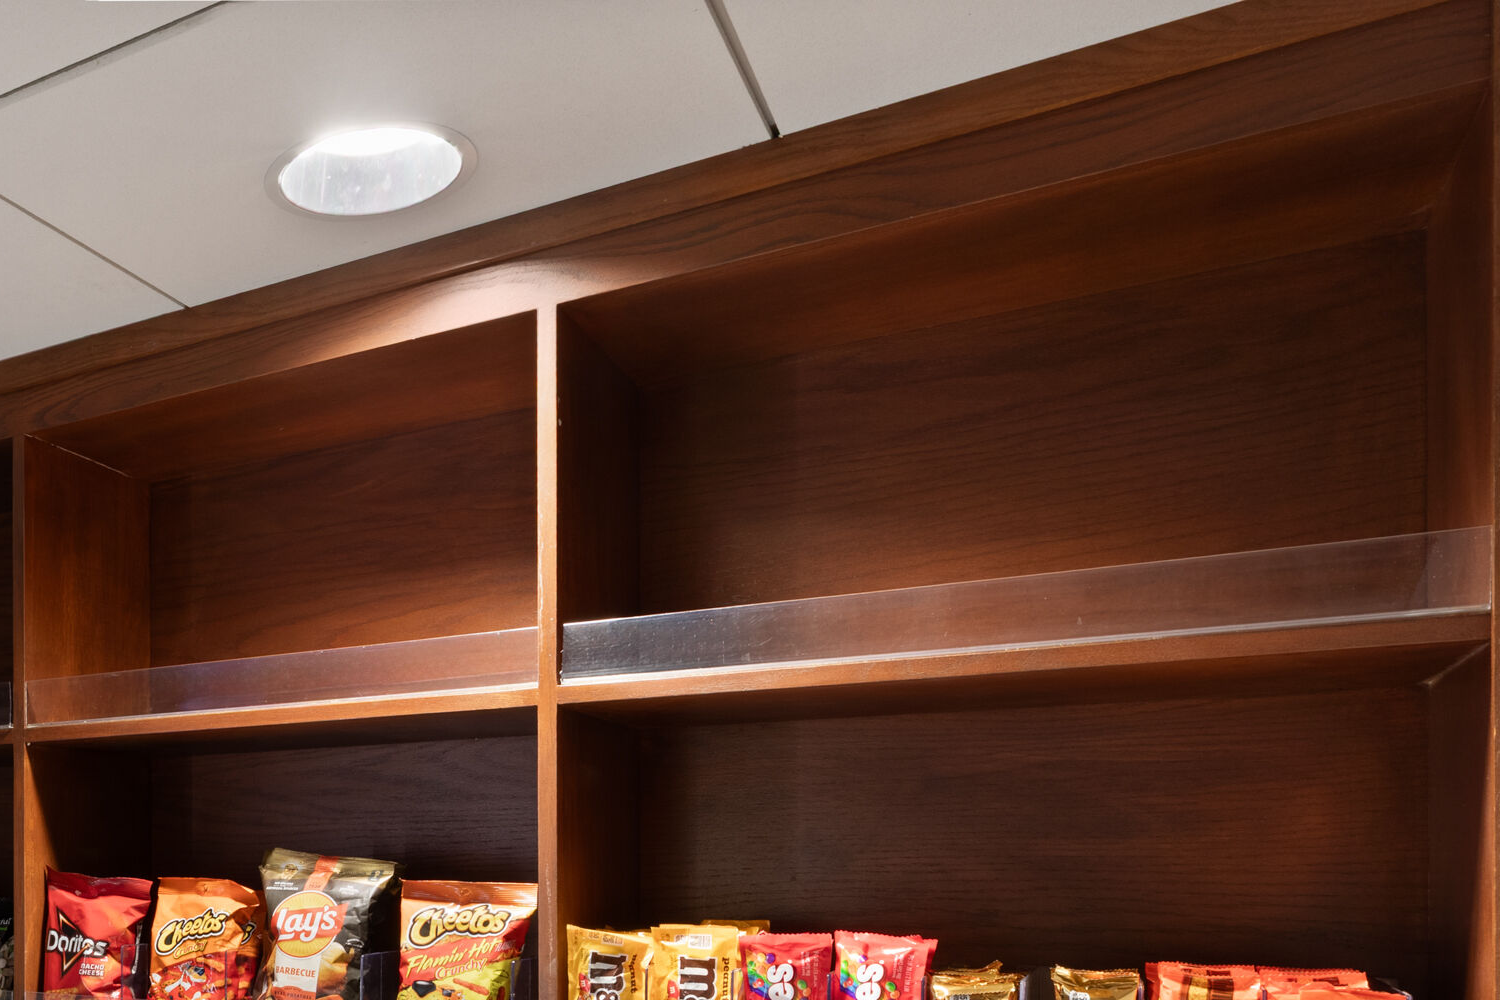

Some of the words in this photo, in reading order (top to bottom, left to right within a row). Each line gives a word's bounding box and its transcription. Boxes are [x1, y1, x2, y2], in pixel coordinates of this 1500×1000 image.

[156, 908, 229, 954] Cheetos
[276, 904, 338, 943] Lay's
[409, 903, 512, 947] Cheetos
[46, 929, 110, 957] Doritos
[405, 946, 466, 979] Flamin'
[467, 938, 503, 958] Hot
[79, 969, 104, 977] CHEESE
[275, 965, 316, 978] BARBECUE
[435, 957, 488, 980] Crunchy
